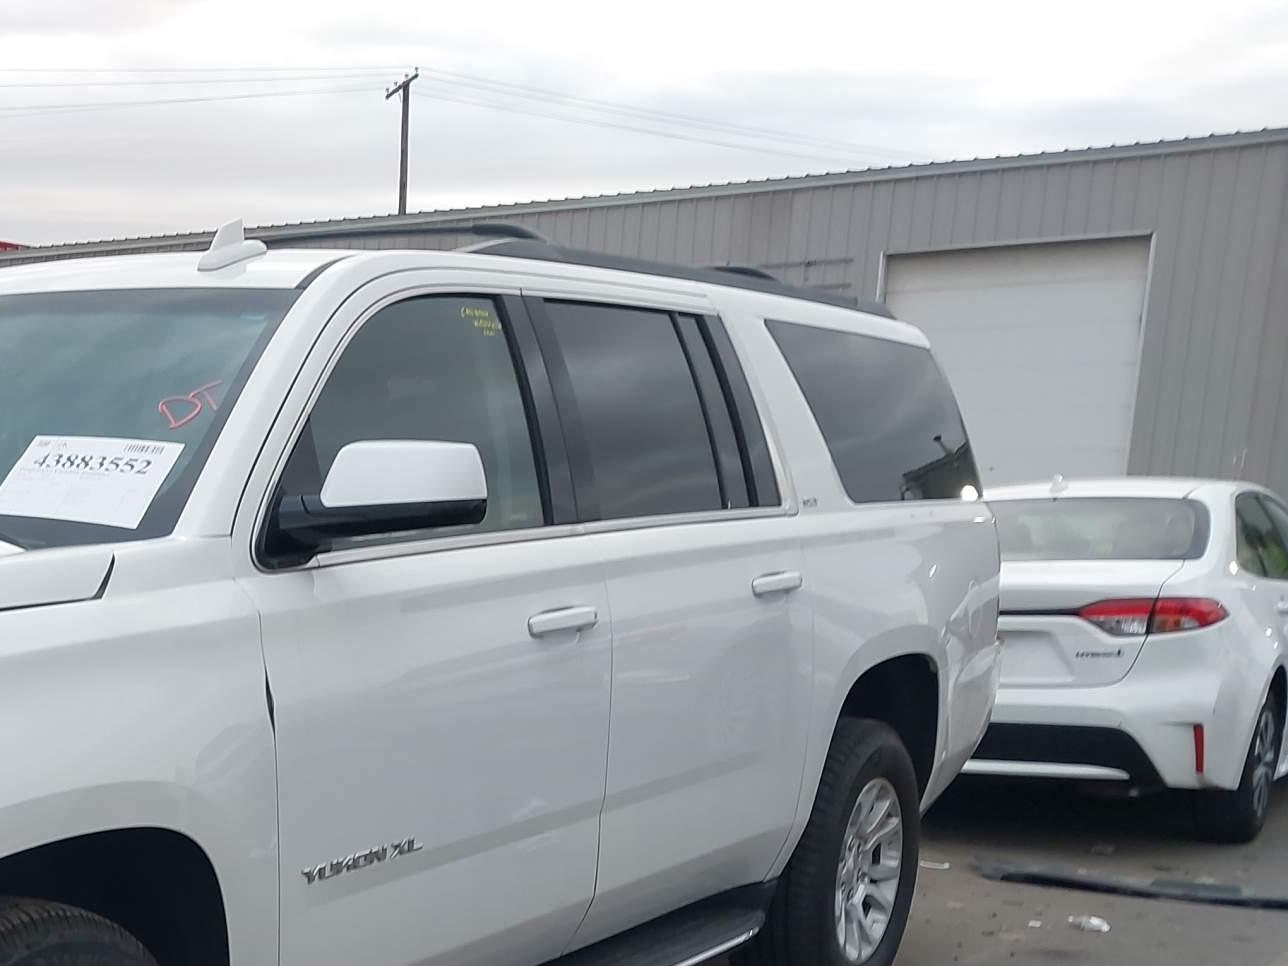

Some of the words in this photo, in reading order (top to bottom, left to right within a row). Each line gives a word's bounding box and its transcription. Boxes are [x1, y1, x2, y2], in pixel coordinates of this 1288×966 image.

[33, 452, 153, 475] 43883552
[301, 845, 388, 885] YUKON
[390, 836, 423, 858] XL
